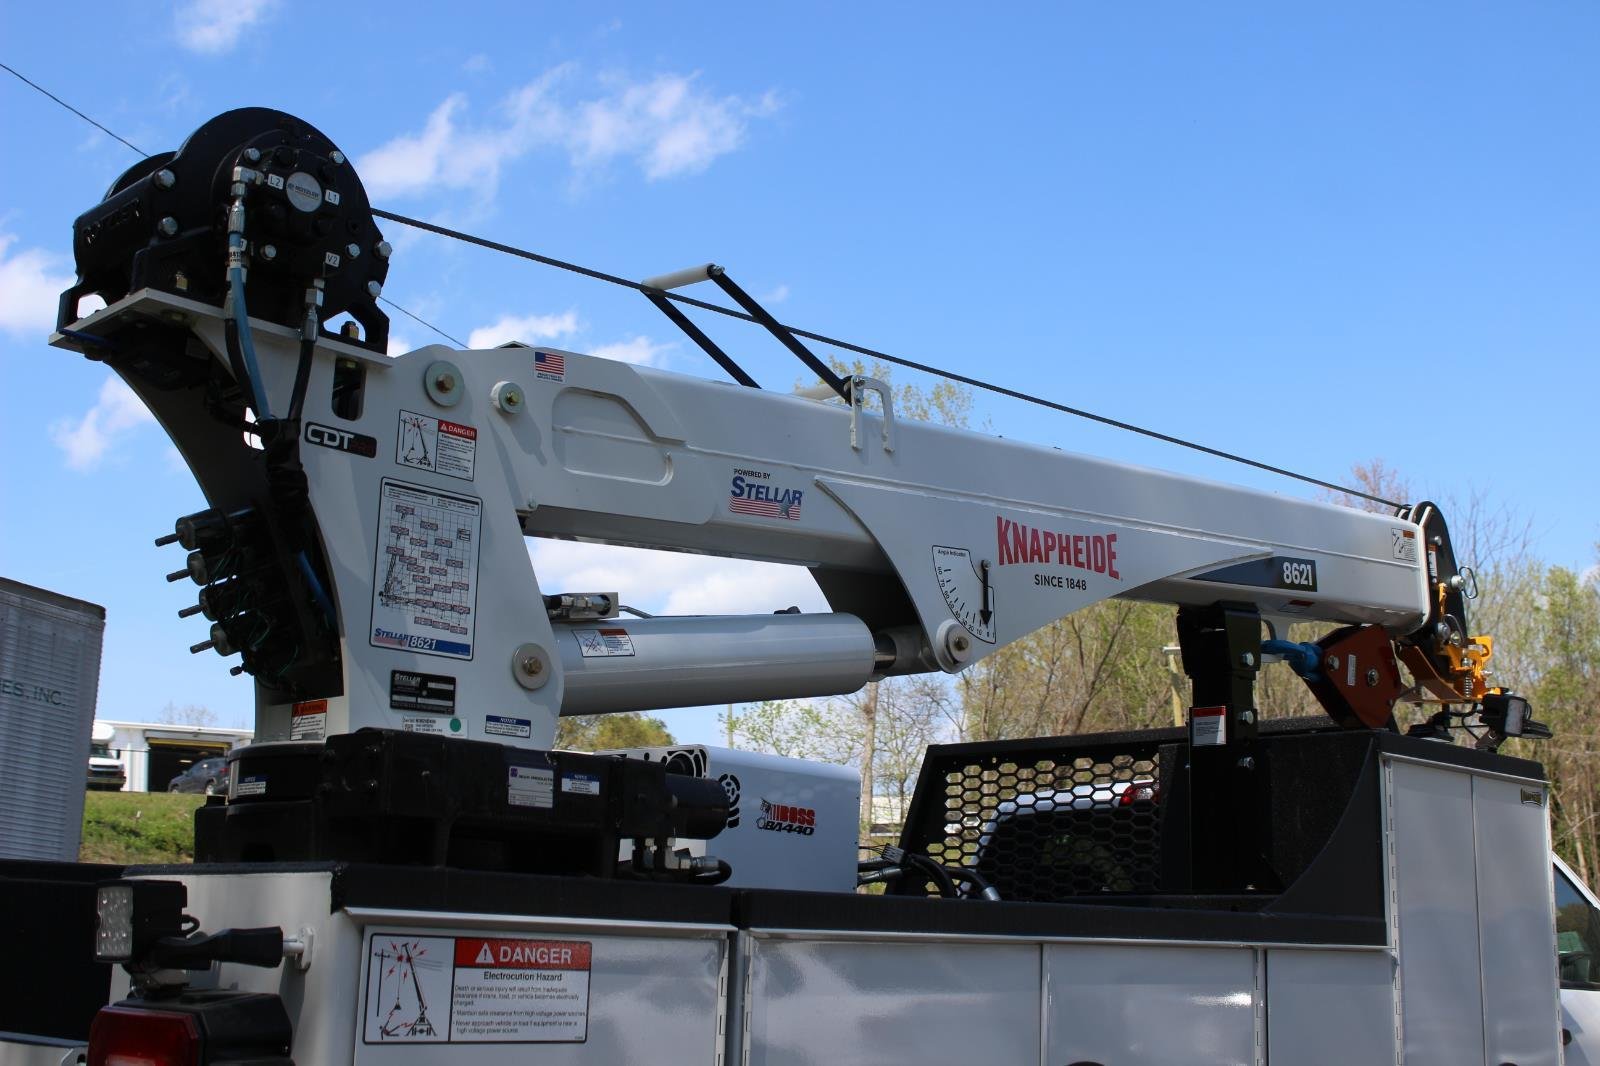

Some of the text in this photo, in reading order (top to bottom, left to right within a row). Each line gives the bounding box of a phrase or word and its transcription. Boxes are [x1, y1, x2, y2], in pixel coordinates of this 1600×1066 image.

[271, 177, 280, 187] L2
[328, 191, 338, 202] L1
[327, 255, 338, 265] V2
[308, 424, 354, 450] CDT
[448, 425, 475, 438] DANGER
[734, 468, 761, 478] POWERED
[731, 475, 803, 506] STELLAR
[997, 515, 1120, 580] KNAPHEIDE
[1034, 574, 1087, 591] SINCE 1848
[1282, 561, 1313, 586] 8621
[374, 627, 437, 650] STELLAR 8621
[779, 805, 815, 827] BOSS
[500, 945, 572, 964] DANGER
[484, 971, 563, 981] Electrocution Hazard
